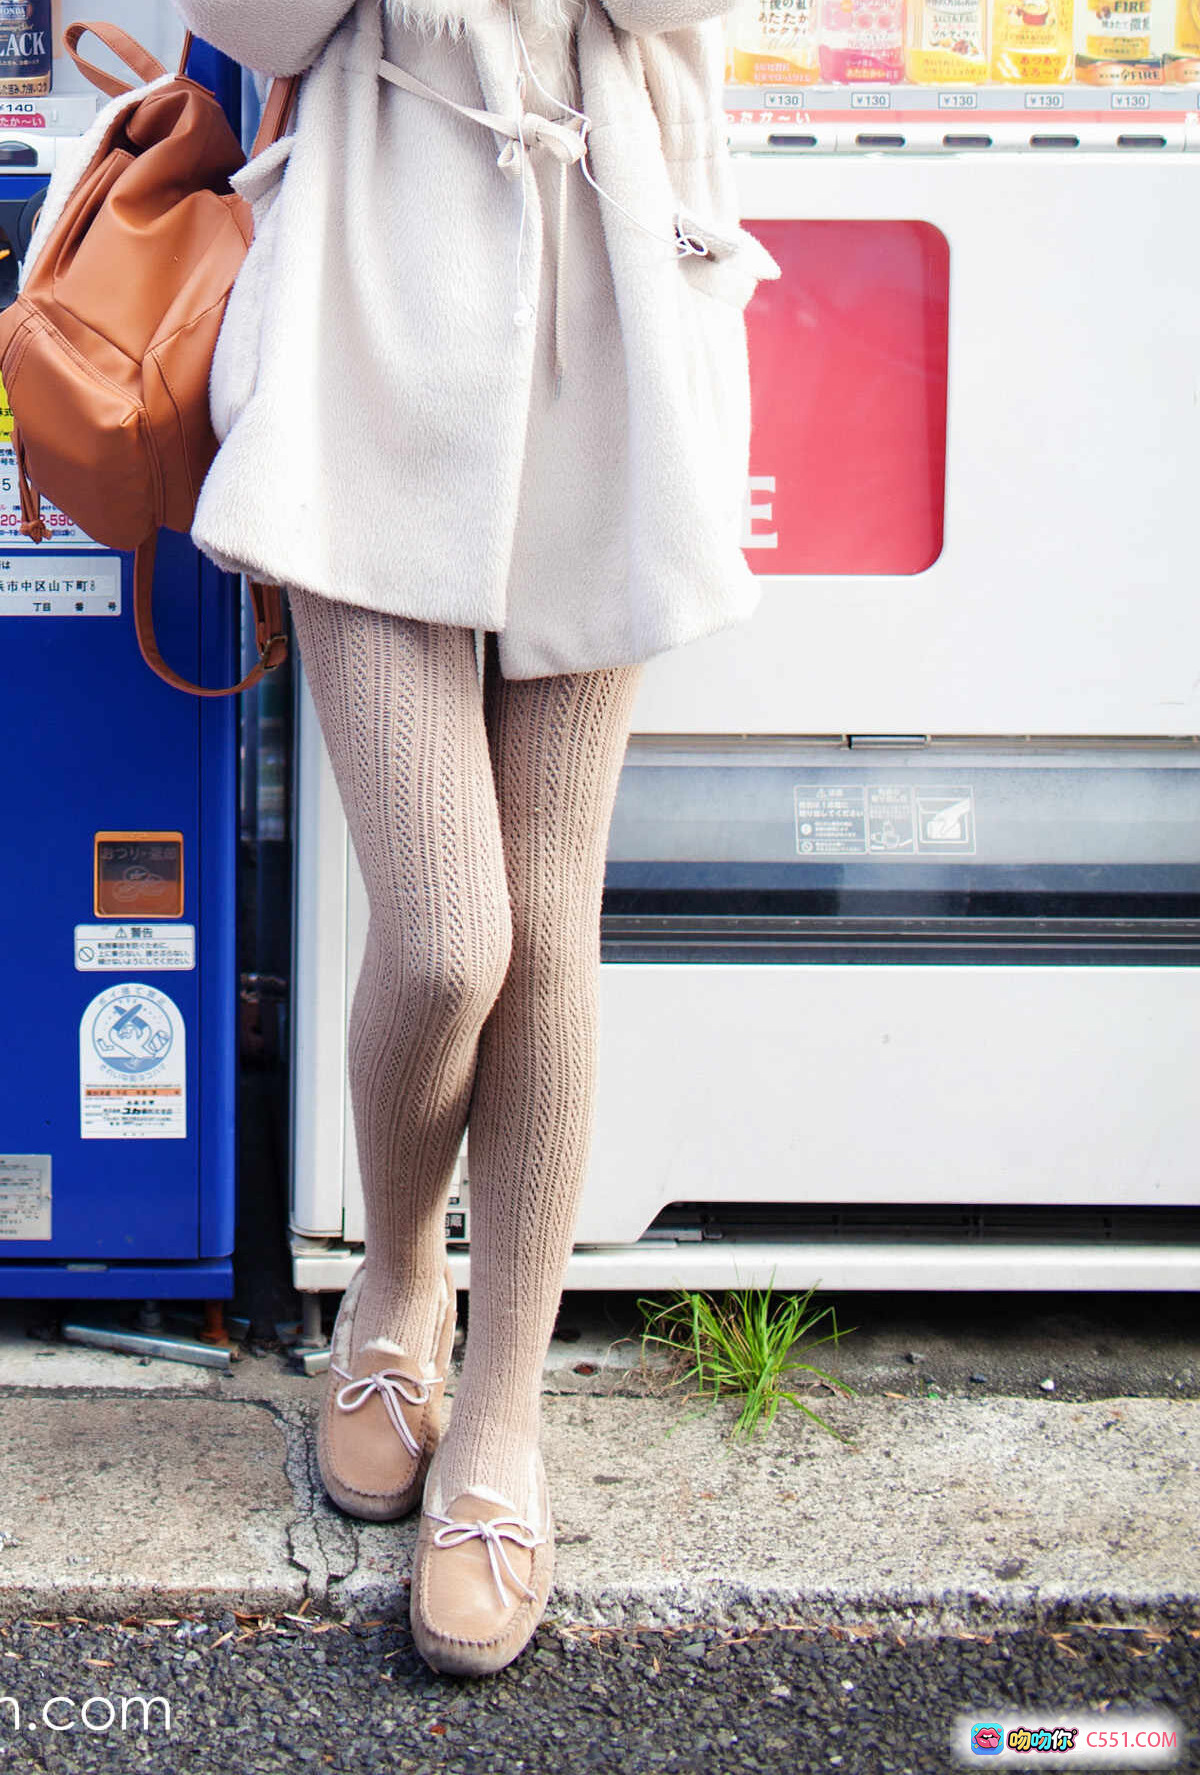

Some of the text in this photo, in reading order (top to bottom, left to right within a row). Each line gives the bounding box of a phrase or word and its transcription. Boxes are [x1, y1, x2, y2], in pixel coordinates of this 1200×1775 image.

[1114, 0, 1146, 13] FIRE
[855, 95, 886, 106] ¥130
[32, 601, 118, 612] 丁目 号
